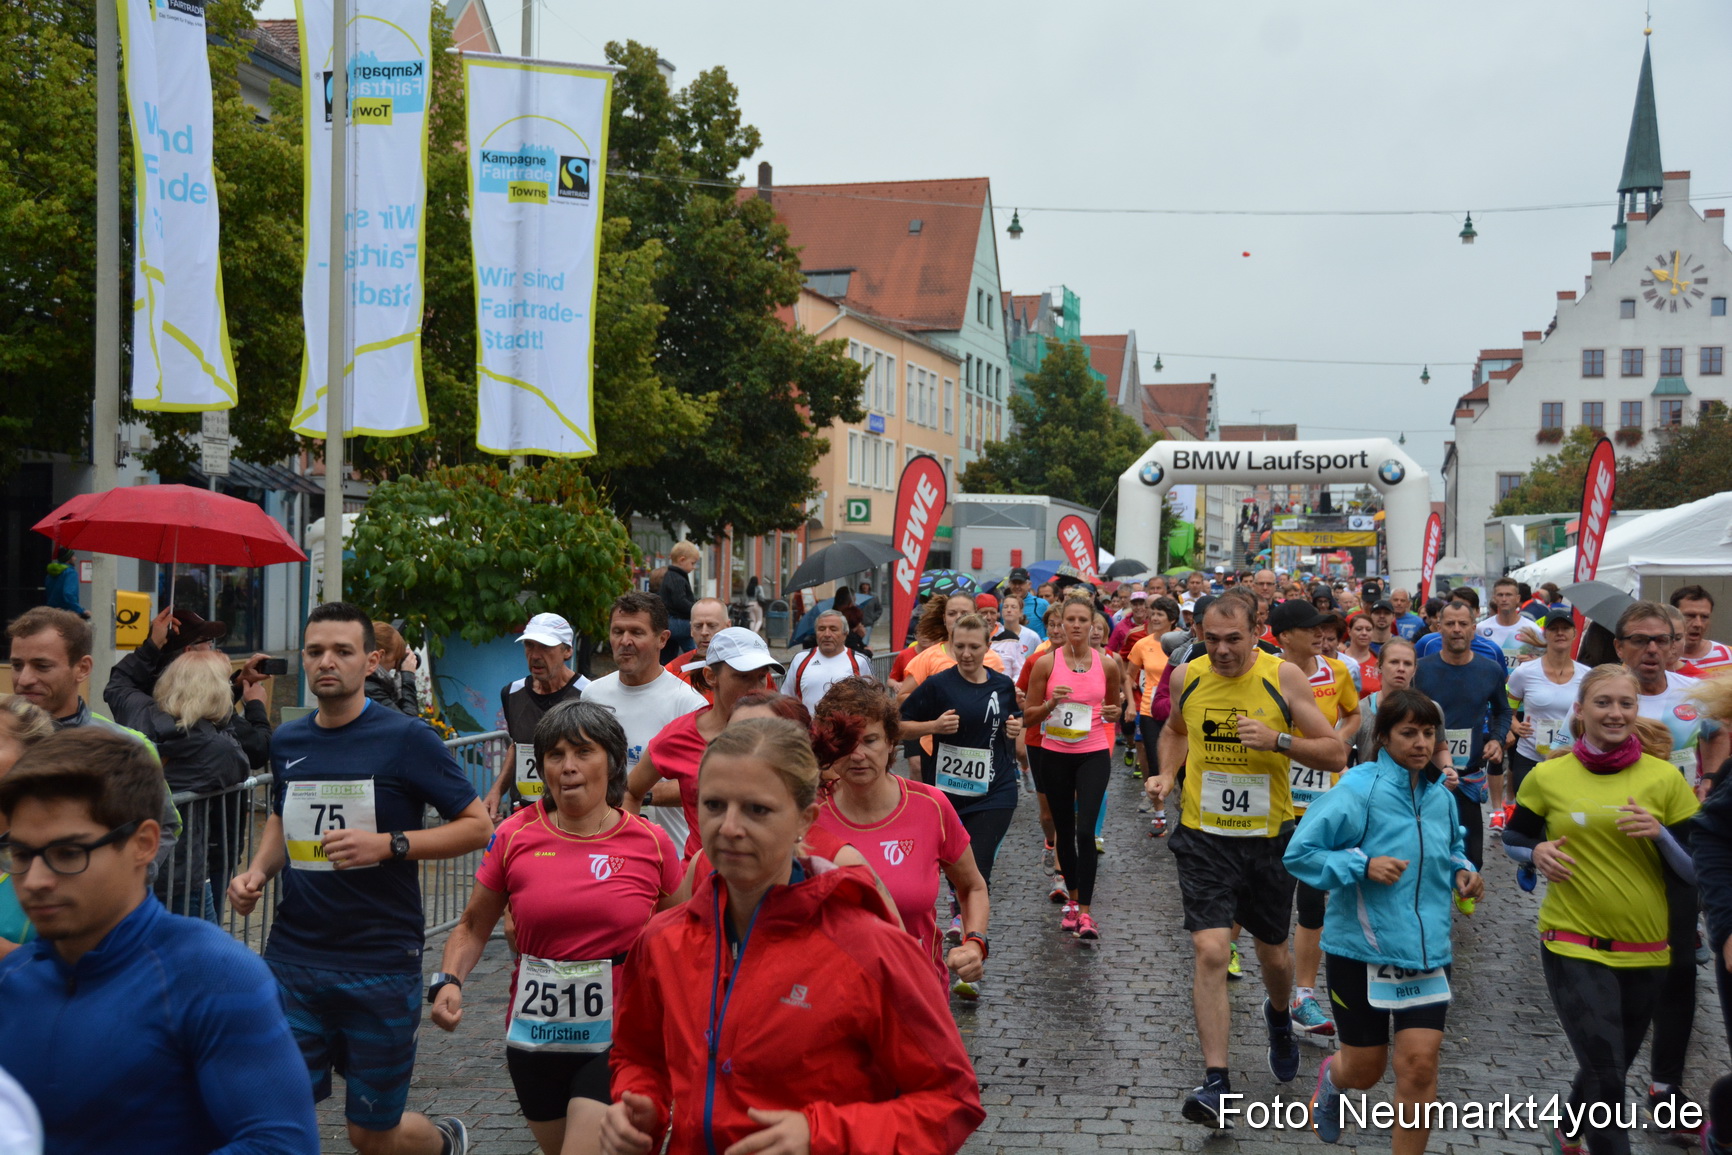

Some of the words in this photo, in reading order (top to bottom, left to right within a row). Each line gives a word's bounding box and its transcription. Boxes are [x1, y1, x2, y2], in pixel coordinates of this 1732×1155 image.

[482, 151, 547, 167] Kampagne
[482, 164, 553, 182] Fairtrade
[510, 186, 547, 199] Towns
[560, 189, 589, 199] FAIRTRADE
[479, 266, 517, 288] Wir
[522, 267, 565, 291] sind
[481, 297, 583, 323] Fairtrade-
[484, 329, 544, 350] Stadt!
[1172, 450, 1240, 471] BMW
[1247, 449, 1369, 474] Laufsport
[850, 502, 867, 519] D
[896, 472, 939, 595] REWE
[1313, 534, 1337, 544] ZIEL
[1423, 520, 1440, 583] REWE
[1063, 711, 1073, 727] 8
[1205, 743, 1247, 754] HIRSCH
[942, 756, 985, 779] 2240
[948, 778, 975, 790] Daniela
[1232, 775, 1264, 785] BOCK
[321, 784, 365, 796] BOCK
[1221, 788, 1250, 812] 94
[310, 804, 346, 836] 75
[1216, 816, 1252, 828] Andreas
[521, 979, 604, 1018] 2516
[531, 1025, 590, 1041] Christine
